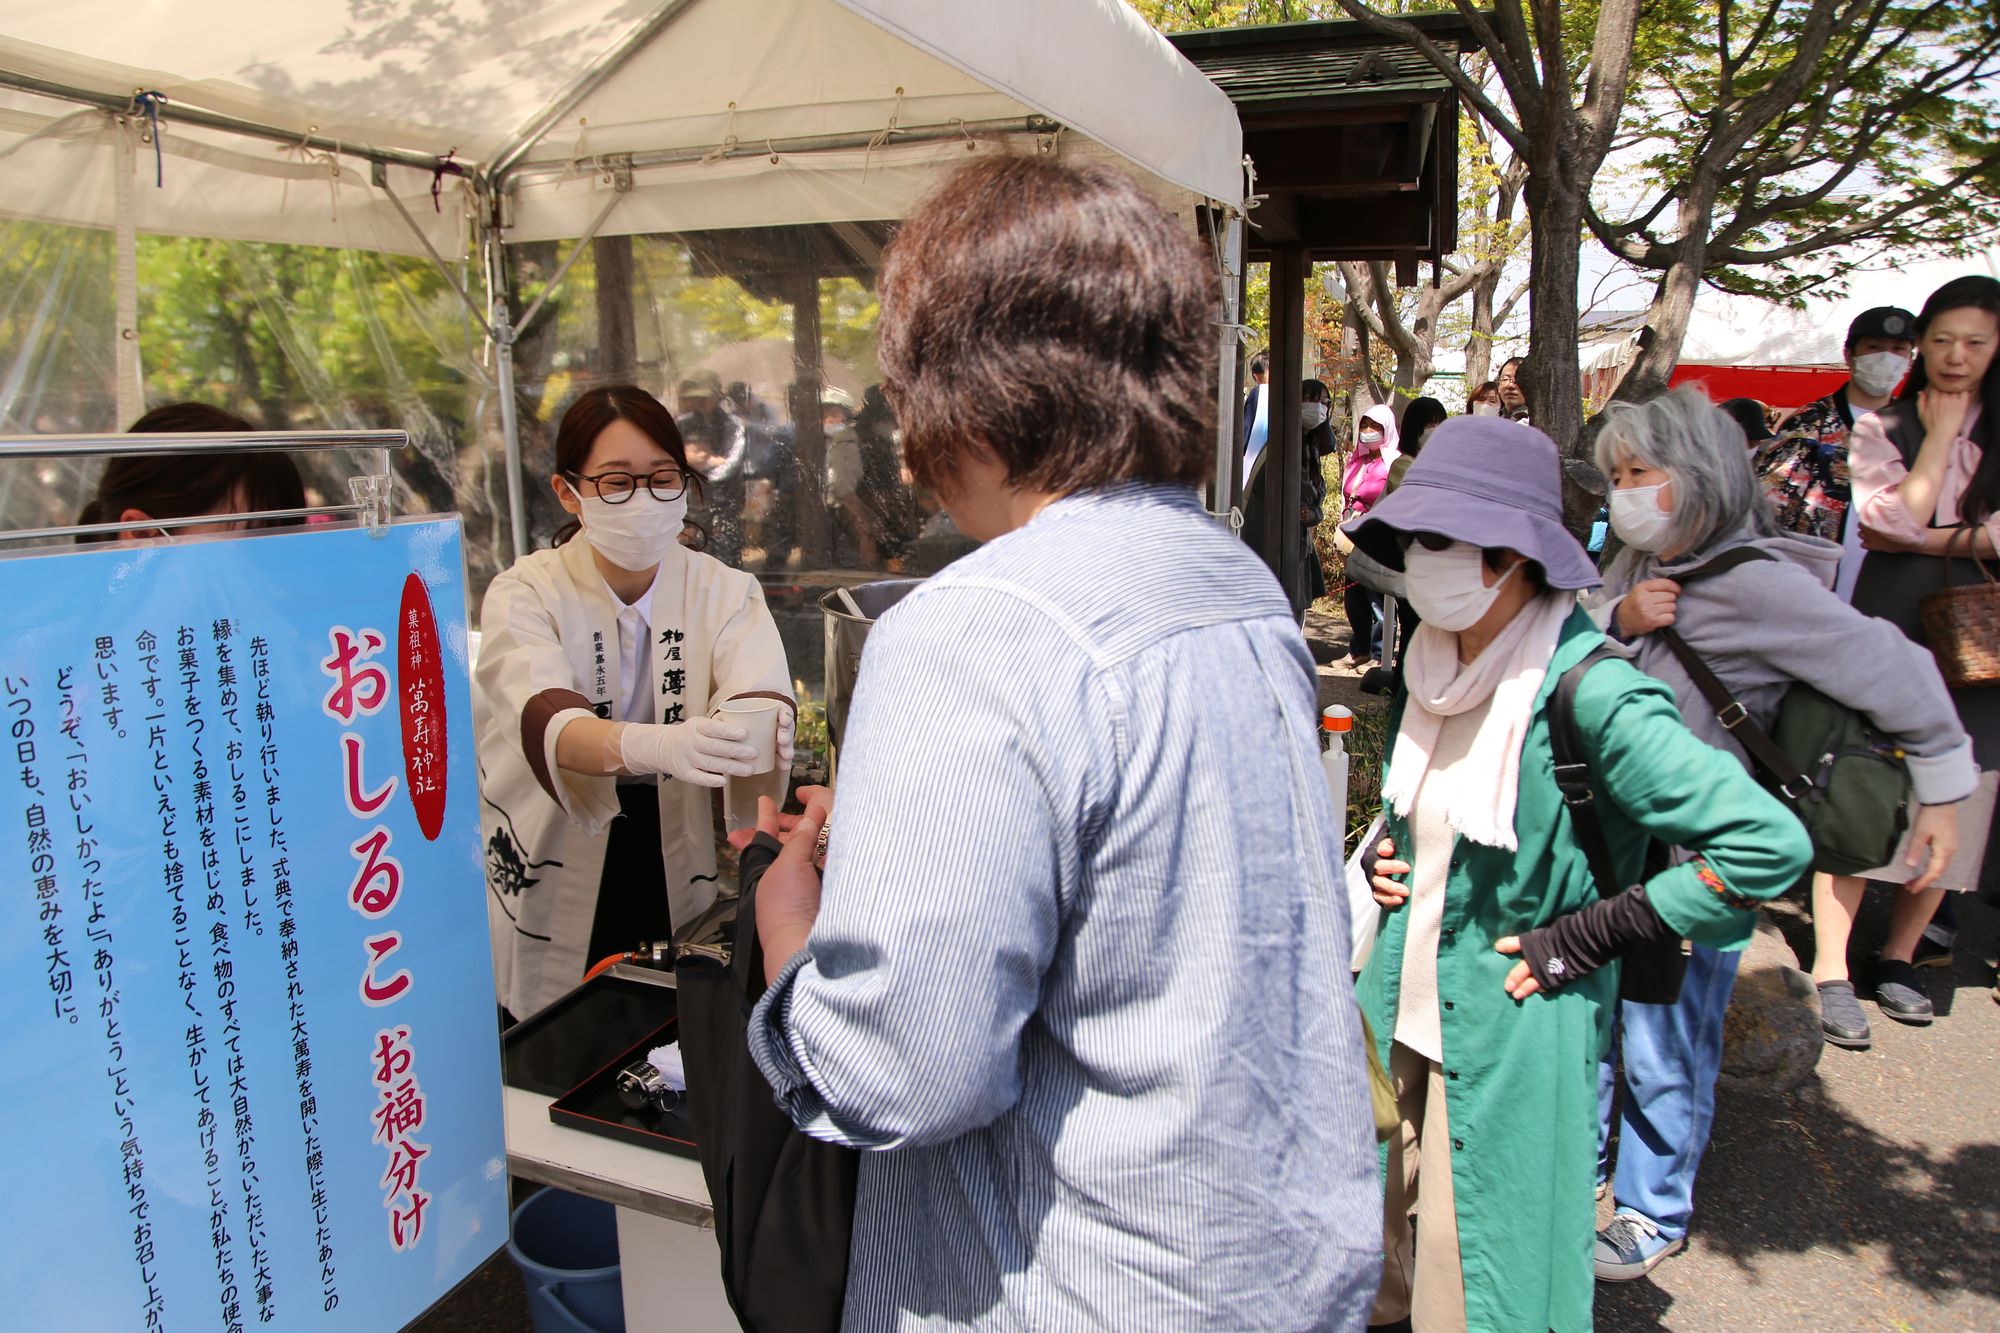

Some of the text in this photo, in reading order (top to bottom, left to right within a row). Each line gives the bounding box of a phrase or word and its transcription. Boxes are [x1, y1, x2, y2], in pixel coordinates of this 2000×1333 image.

[94, 635, 127, 739] 思います。
[212, 618, 265, 937] 縁を集めて、おしるこにしました。
[408, 608, 436, 796] 菓祖神 萬寿神社
[592, 630, 607, 697] 創業嘉永五年
[658, 628, 685, 661] 柏屋
[5, 675, 79, 1026] いつの日も、自然の恵みを大切に。
[176, 625, 275, 1323] お菓子をつくる素材をはじめ、食べ物のすべては大自然からいただいた大事な
[250, 636, 339, 1313] 先ほど執り行いました、式典で奉納された大萬寿を開いた際に生じたあんこの
[322, 627, 430, 1250] おしるこ お福分け
